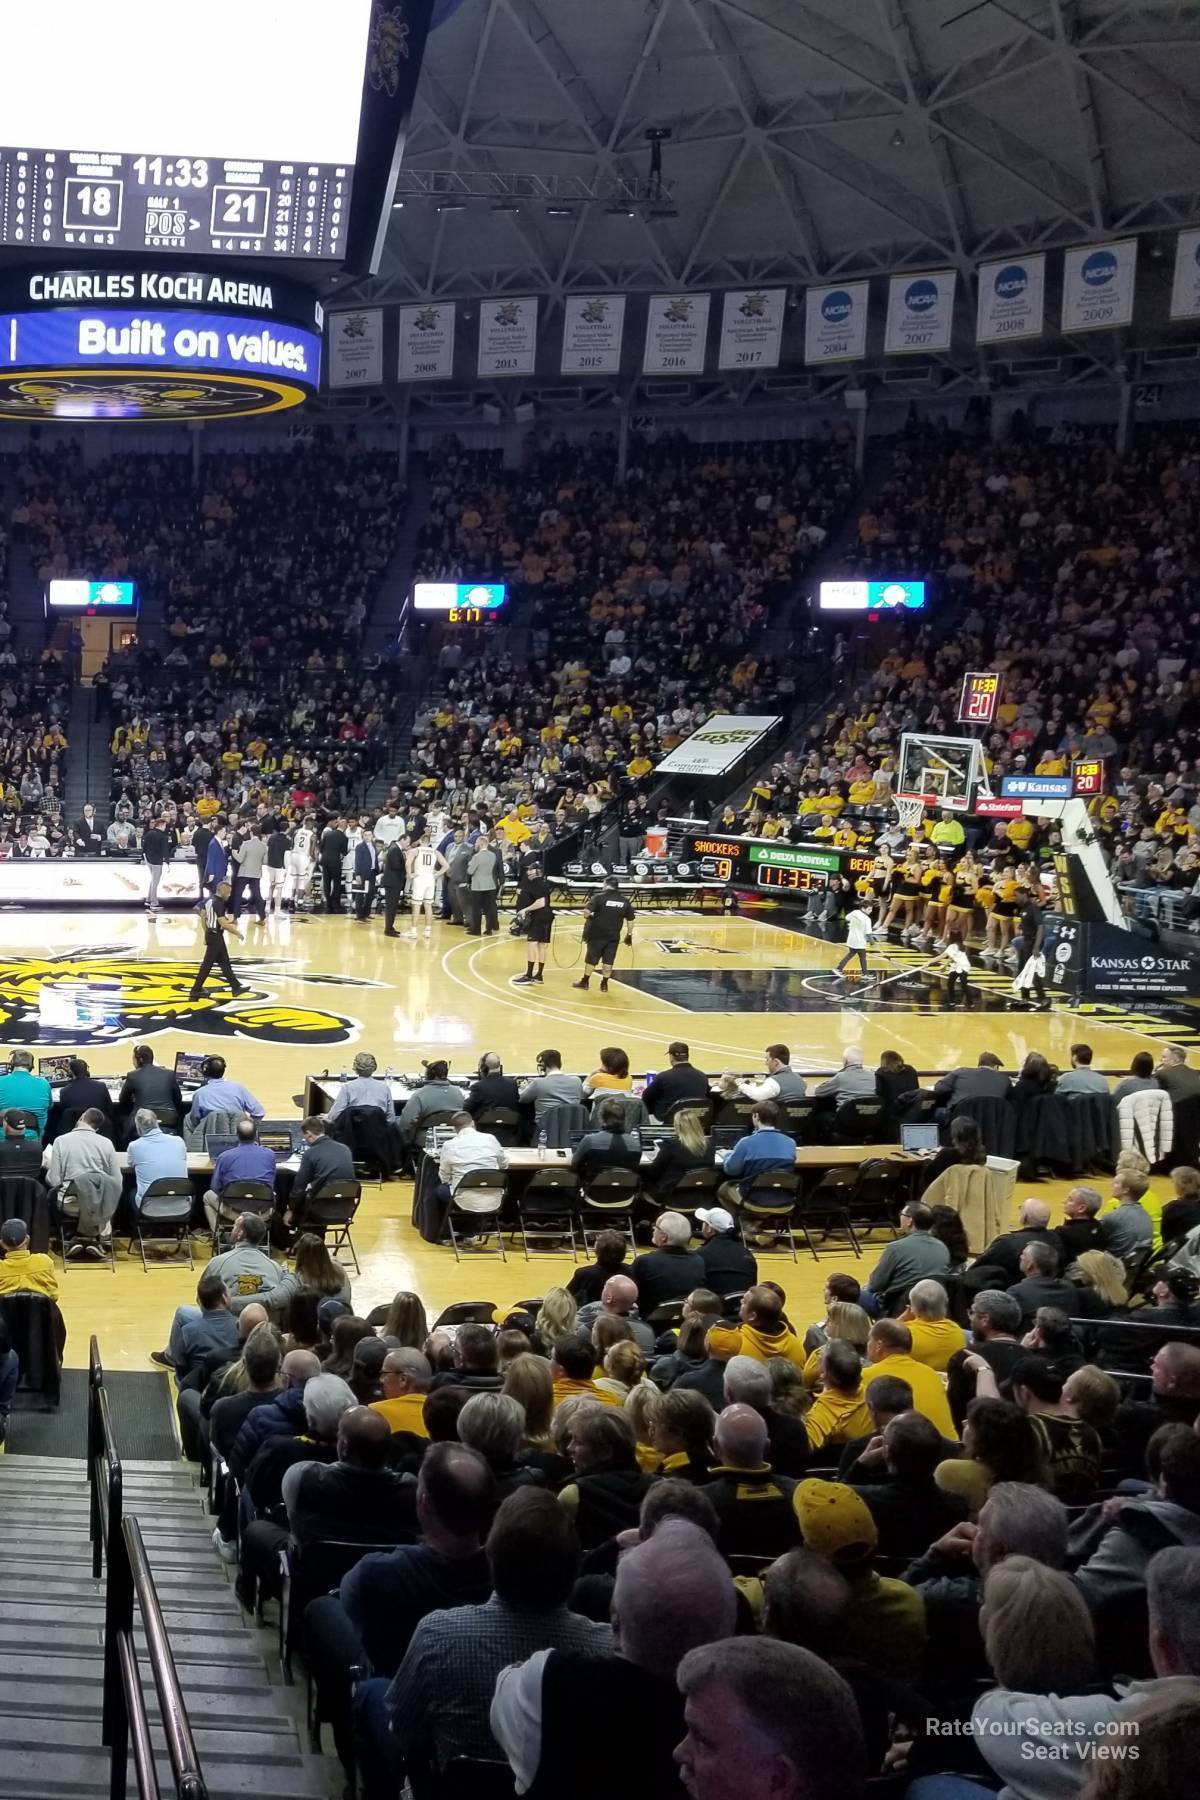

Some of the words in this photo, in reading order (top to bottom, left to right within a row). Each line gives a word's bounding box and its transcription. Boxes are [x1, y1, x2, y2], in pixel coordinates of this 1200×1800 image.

[46, 168, 54, 180] 0
[133, 156, 208, 188] 11:33
[18, 182, 26, 194] 0
[46, 182, 52, 194] 1
[282, 180, 290, 192] 0
[309, 180, 316, 192] 0
[335, 182, 342, 194] 1
[17, 197, 25, 209] 0
[44, 198, 52, 210] 0
[77, 186, 111, 216] 18
[173, 198, 180, 210] 1
[278, 194, 292, 206] 20
[308, 196, 315, 208] 0
[334, 197, 342, 209] 0
[223, 194, 256, 222] 21
[16, 212, 24, 224] 4
[43, 214, 51, 226] 0
[276, 210, 290, 222] 21
[332, 212, 340, 224] 0
[145, 212, 186, 235] POS
[15, 227, 23, 240] 0
[42, 229, 50, 241] 0
[79, 232, 86, 244] 4
[330, 227, 338, 239] 0
[107, 234, 114, 245] 3
[144, 238, 185, 247] BONUS
[226, 239, 233, 250] 4
[254, 240, 261, 251] 3
[274, 239, 287, 251] 34
[303, 240, 311, 252] 4
[330, 241, 336, 254] 1
[1086, 266, 1117, 278] NCAA
[29, 275, 134, 300] CHARLES
[140, 274, 202, 300] KOCH
[207, 278, 273, 308] ARENA
[997, 280, 1026, 292] NCAA
[908, 294, 937, 304] NCAA
[824, 304, 852, 316] NCAA
[1082, 307, 1113, 321] 2009
[996, 319, 1025, 333] 2008
[904, 333, 933, 344] 2007
[78, 319, 166, 356] Built
[173, 329, 219, 358] on
[227, 330, 308, 373] values.
[823, 343, 847, 354] 2004
[579, 357, 602, 367] 2015
[662, 357, 685, 367] 2016
[736, 352, 761, 362] 2017
[414, 362, 437, 373] 2008
[495, 359, 518, 369] 2013
[345, 369, 367, 379] 2007
[449, 608, 480, 621] 6:17
[972, 679, 995, 692] 11:33
[968, 694, 990, 717] 20
[1077, 764, 1098, 775] 11:33
[1027, 782, 1067, 792] Kansas
[1077, 776, 1093, 789] 20
[299, 837, 304, 848] 2
[695, 841, 740, 856] SHOCKERS
[422, 854, 432, 866] 10
[770, 850, 800, 861] DELTA
[802, 854, 831, 866] DENTAL
[765, 868, 810, 888] 11:33
[1053, 855, 1075, 915] WSU
[606, 900, 624, 908] ESPN
[1091, 956, 1138, 969] KANSAS
[1157, 958, 1190, 970] STAR
